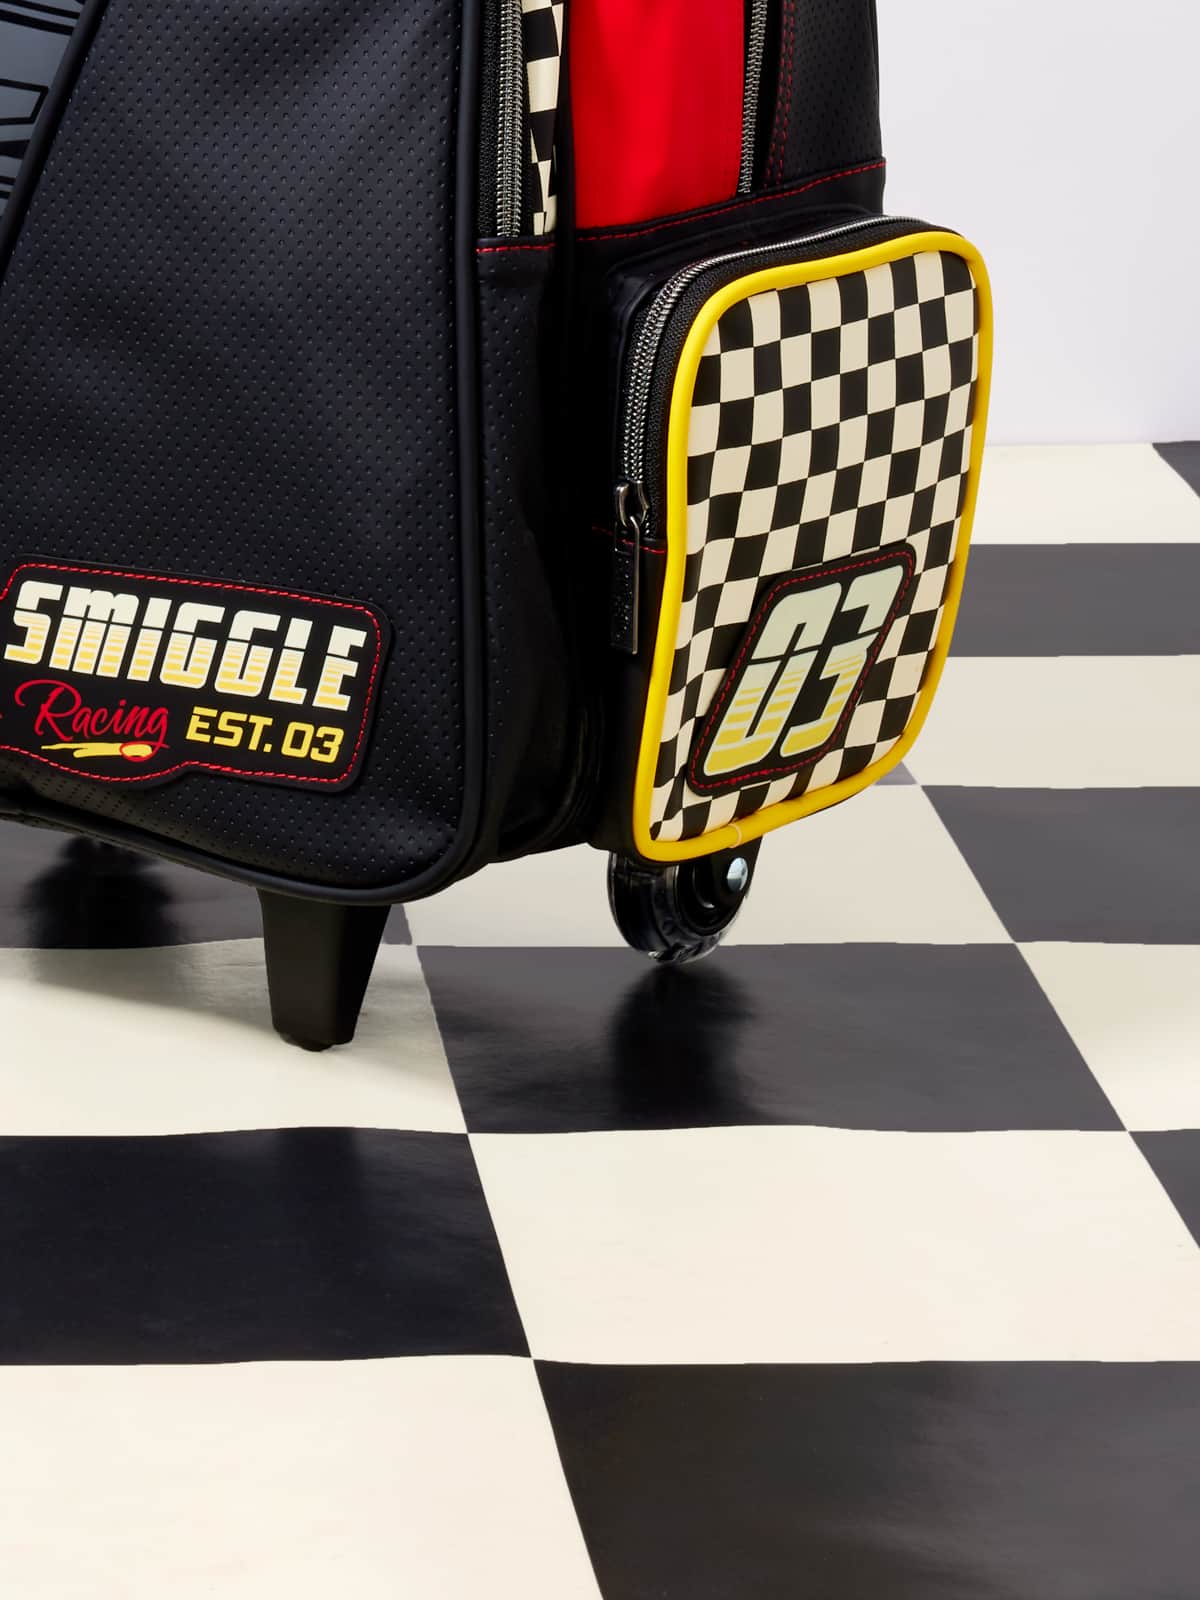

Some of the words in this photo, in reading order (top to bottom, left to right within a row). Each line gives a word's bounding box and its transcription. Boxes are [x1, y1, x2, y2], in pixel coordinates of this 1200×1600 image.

[3, 580, 368, 712] SMIGGLE
[702, 563, 906, 777] 03
[14, 679, 170, 749] Racing
[185, 705, 272, 753] EST.
[281, 721, 345, 764] 03
